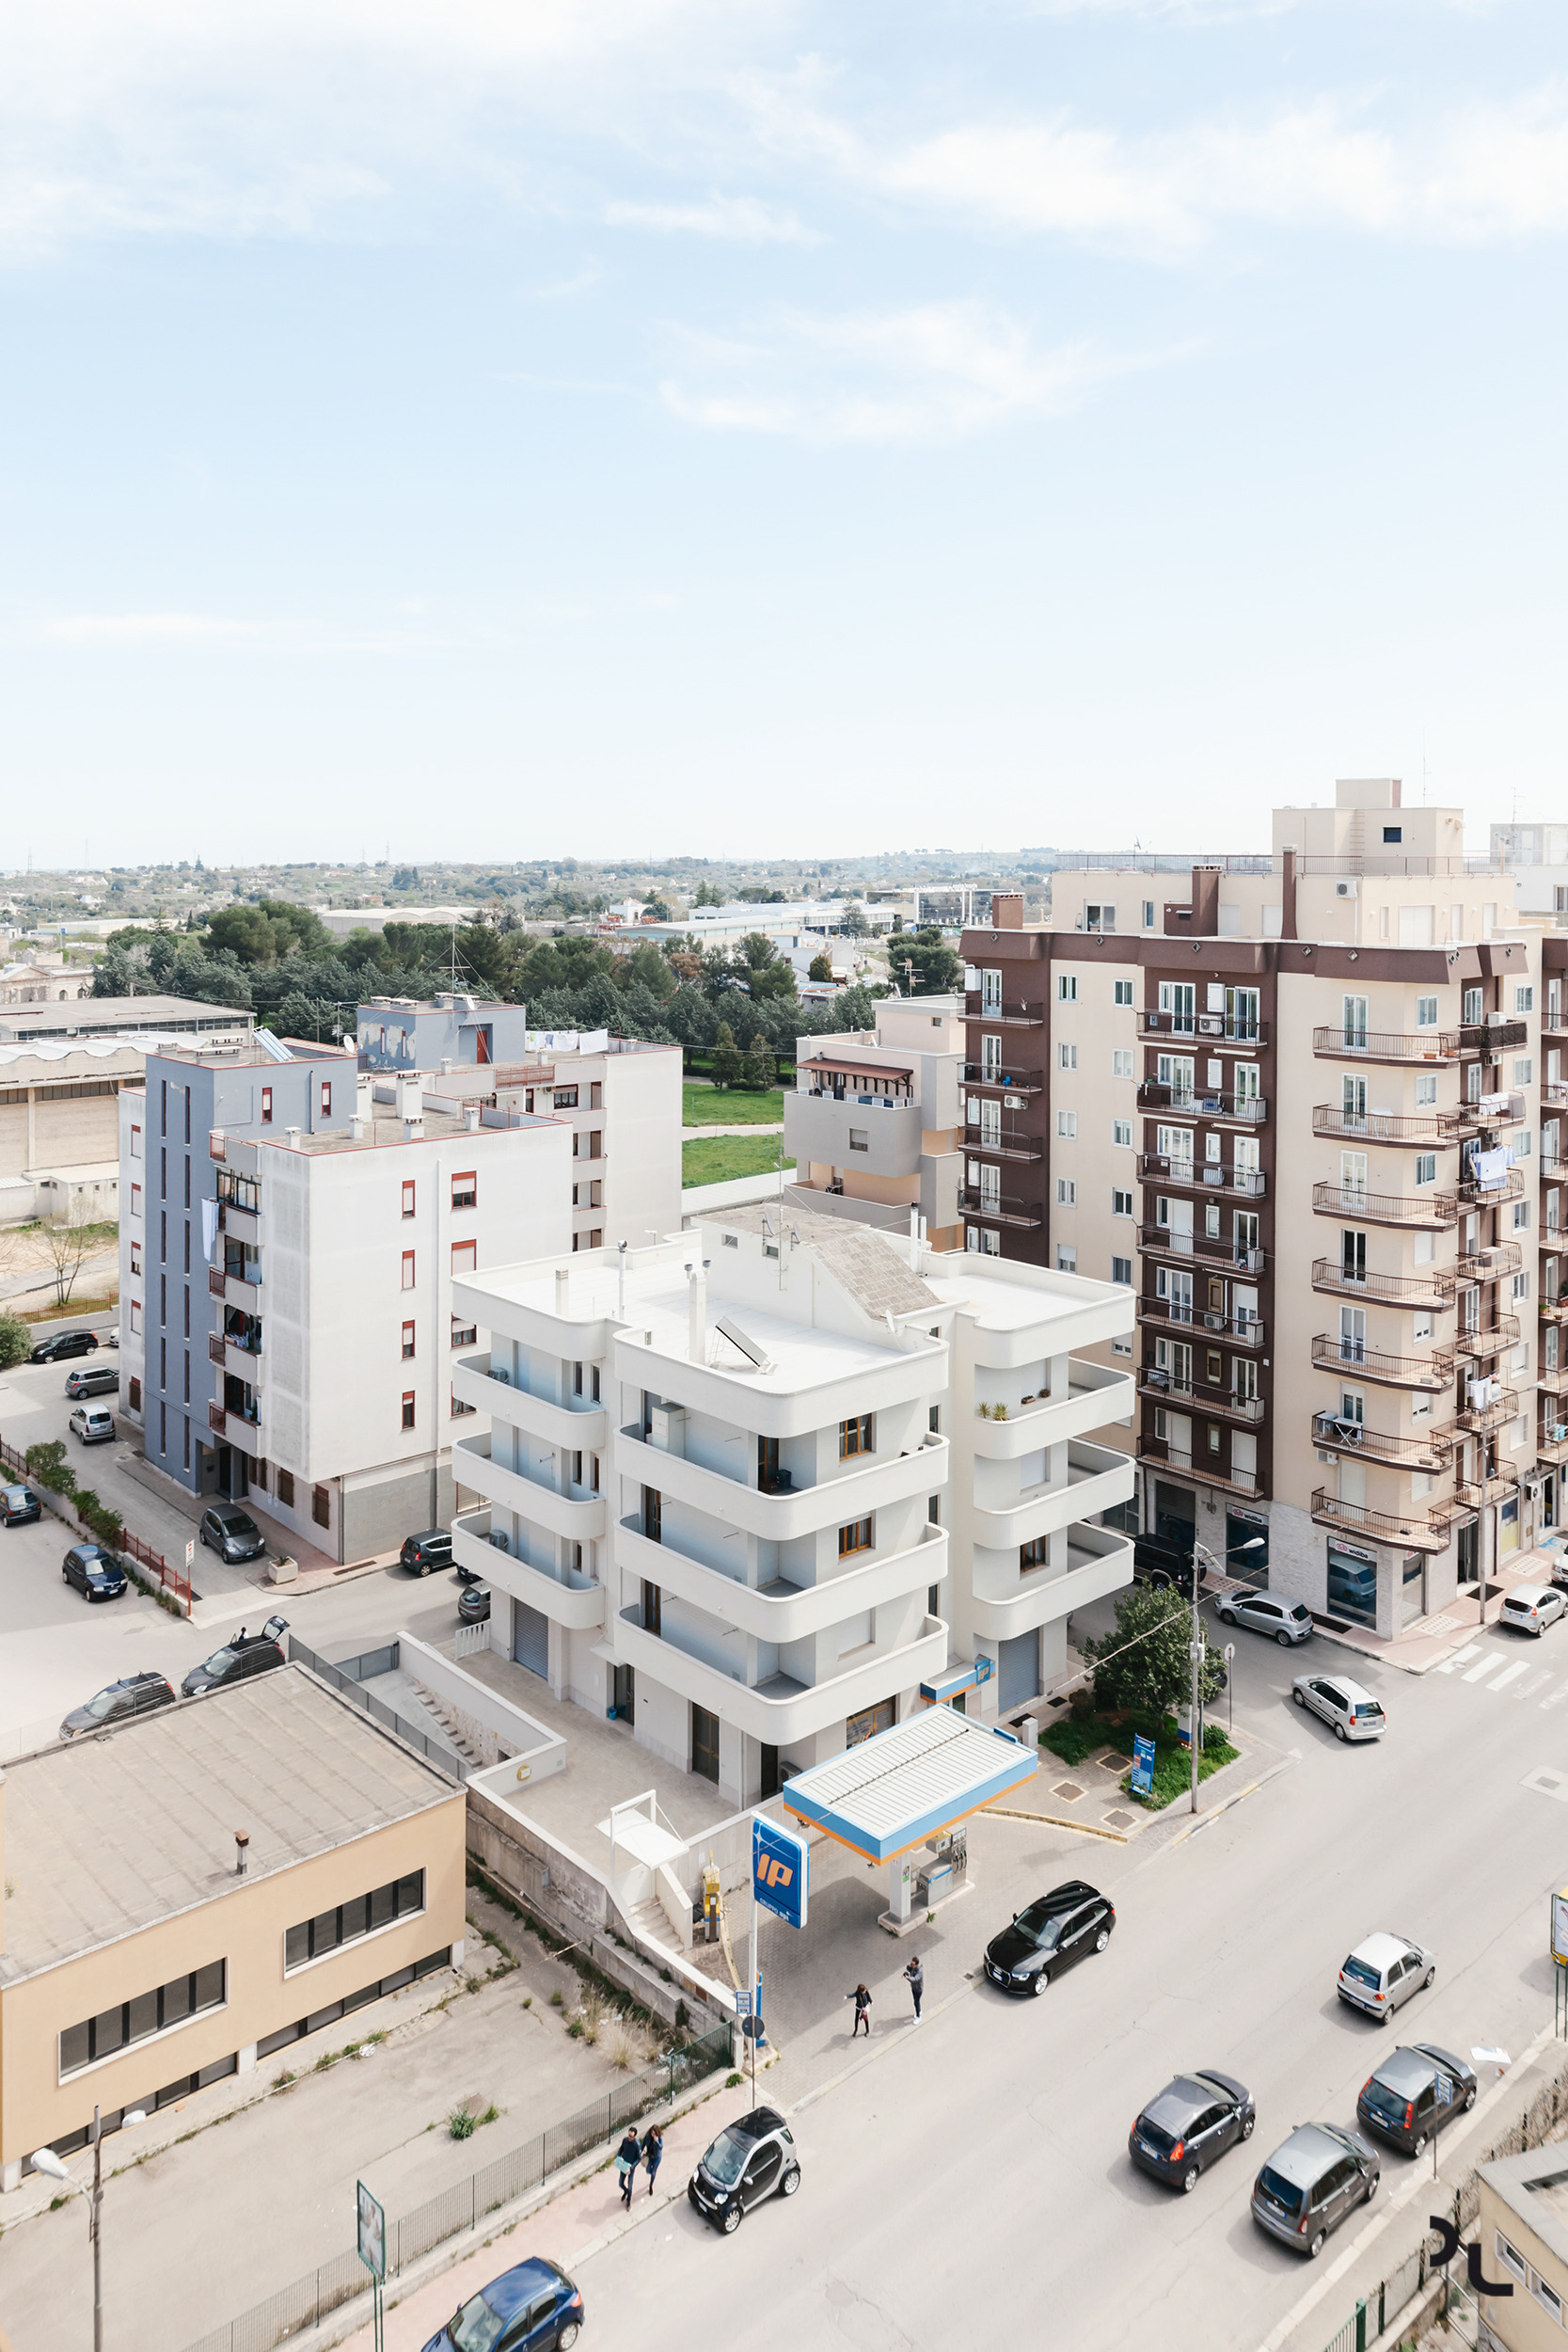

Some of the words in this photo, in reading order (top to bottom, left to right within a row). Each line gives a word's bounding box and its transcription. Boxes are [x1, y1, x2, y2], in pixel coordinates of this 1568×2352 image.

[1244, 1513, 1262, 1523] widiba
[1348, 1548, 1369, 1559] widiba
[978, 1666, 989, 1681] IP
[756, 1853, 794, 1887] IP
[759, 1898, 779, 1915] GRUPPO
